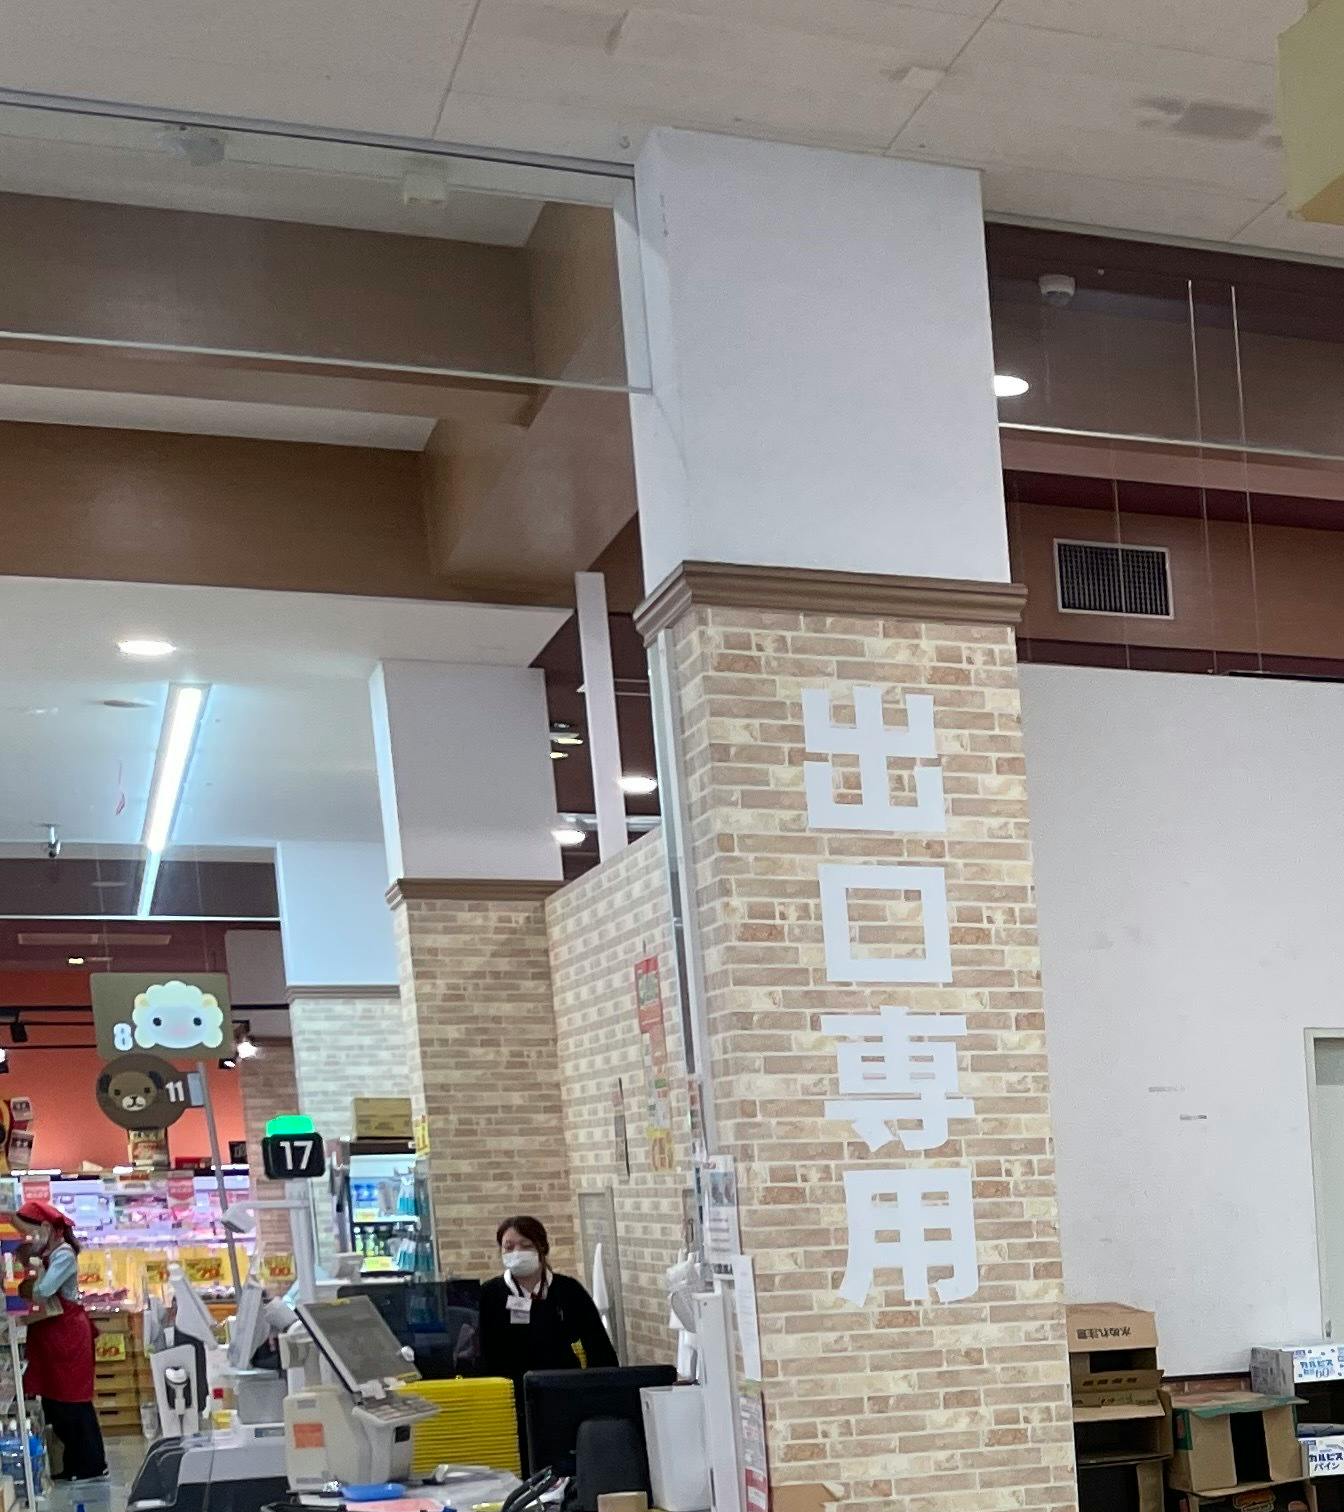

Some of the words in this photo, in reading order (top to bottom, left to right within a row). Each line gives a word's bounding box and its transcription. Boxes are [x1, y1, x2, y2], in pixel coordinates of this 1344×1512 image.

[802, 686, 979, 1307] 出口専用
[165, 1080, 185, 1103] 11
[280, 1140, 314, 1170] 17
[1308, 1452, 1344, 1463] カルピス
